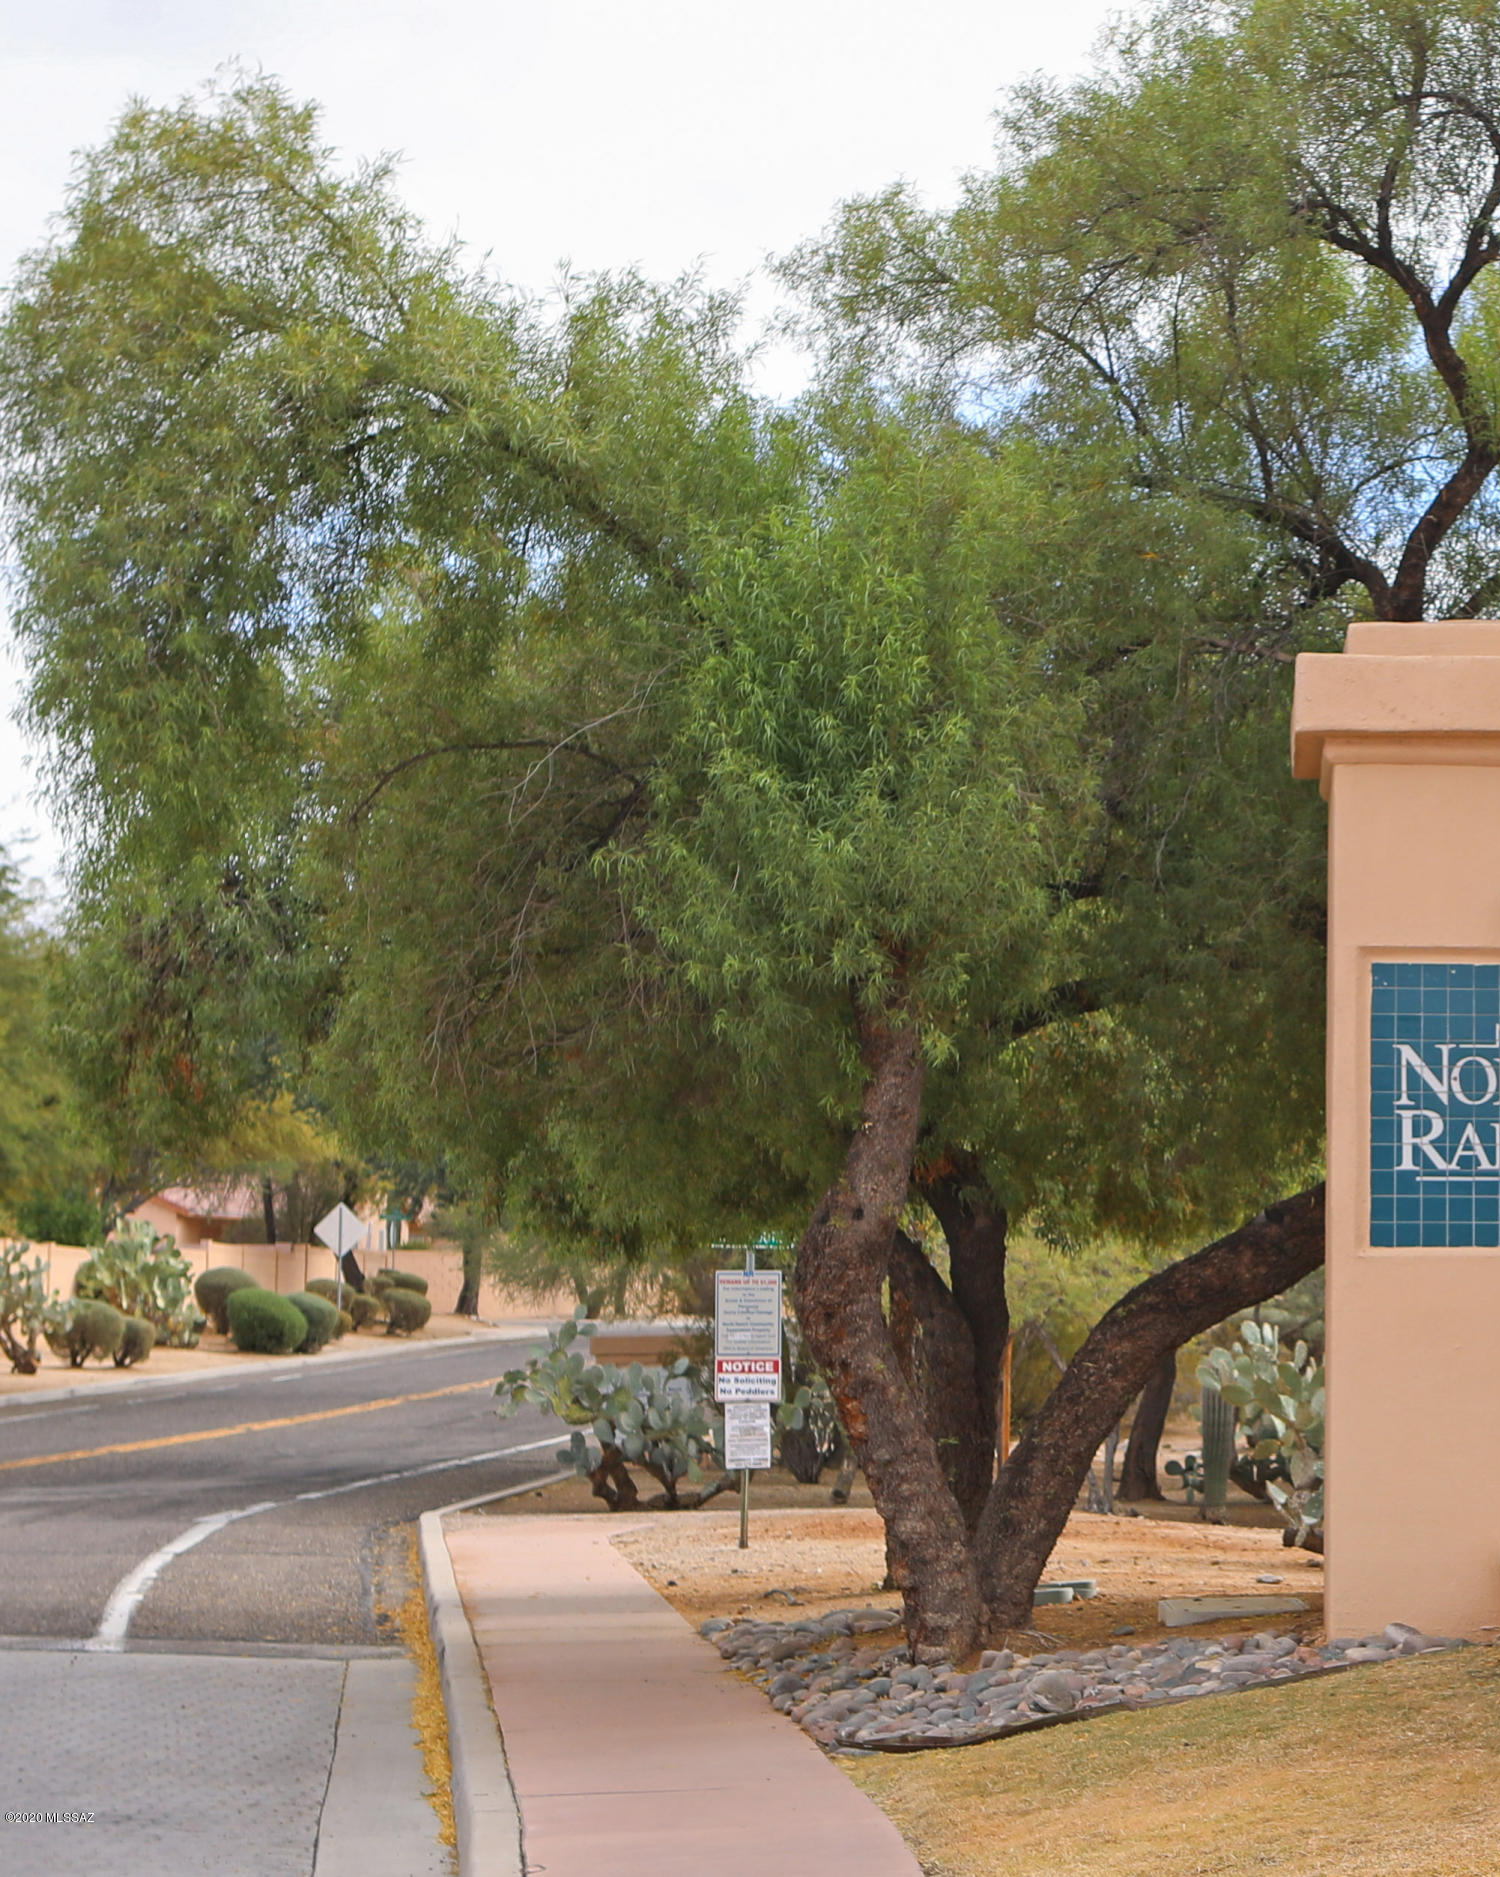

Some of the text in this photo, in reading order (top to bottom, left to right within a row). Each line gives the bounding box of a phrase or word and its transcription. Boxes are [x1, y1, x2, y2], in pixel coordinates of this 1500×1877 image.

[722, 1361, 774, 1372] NOTICE
[719, 1376, 777, 1386] No Soliciting
[720, 1387, 775, 1395] No Peddlers
